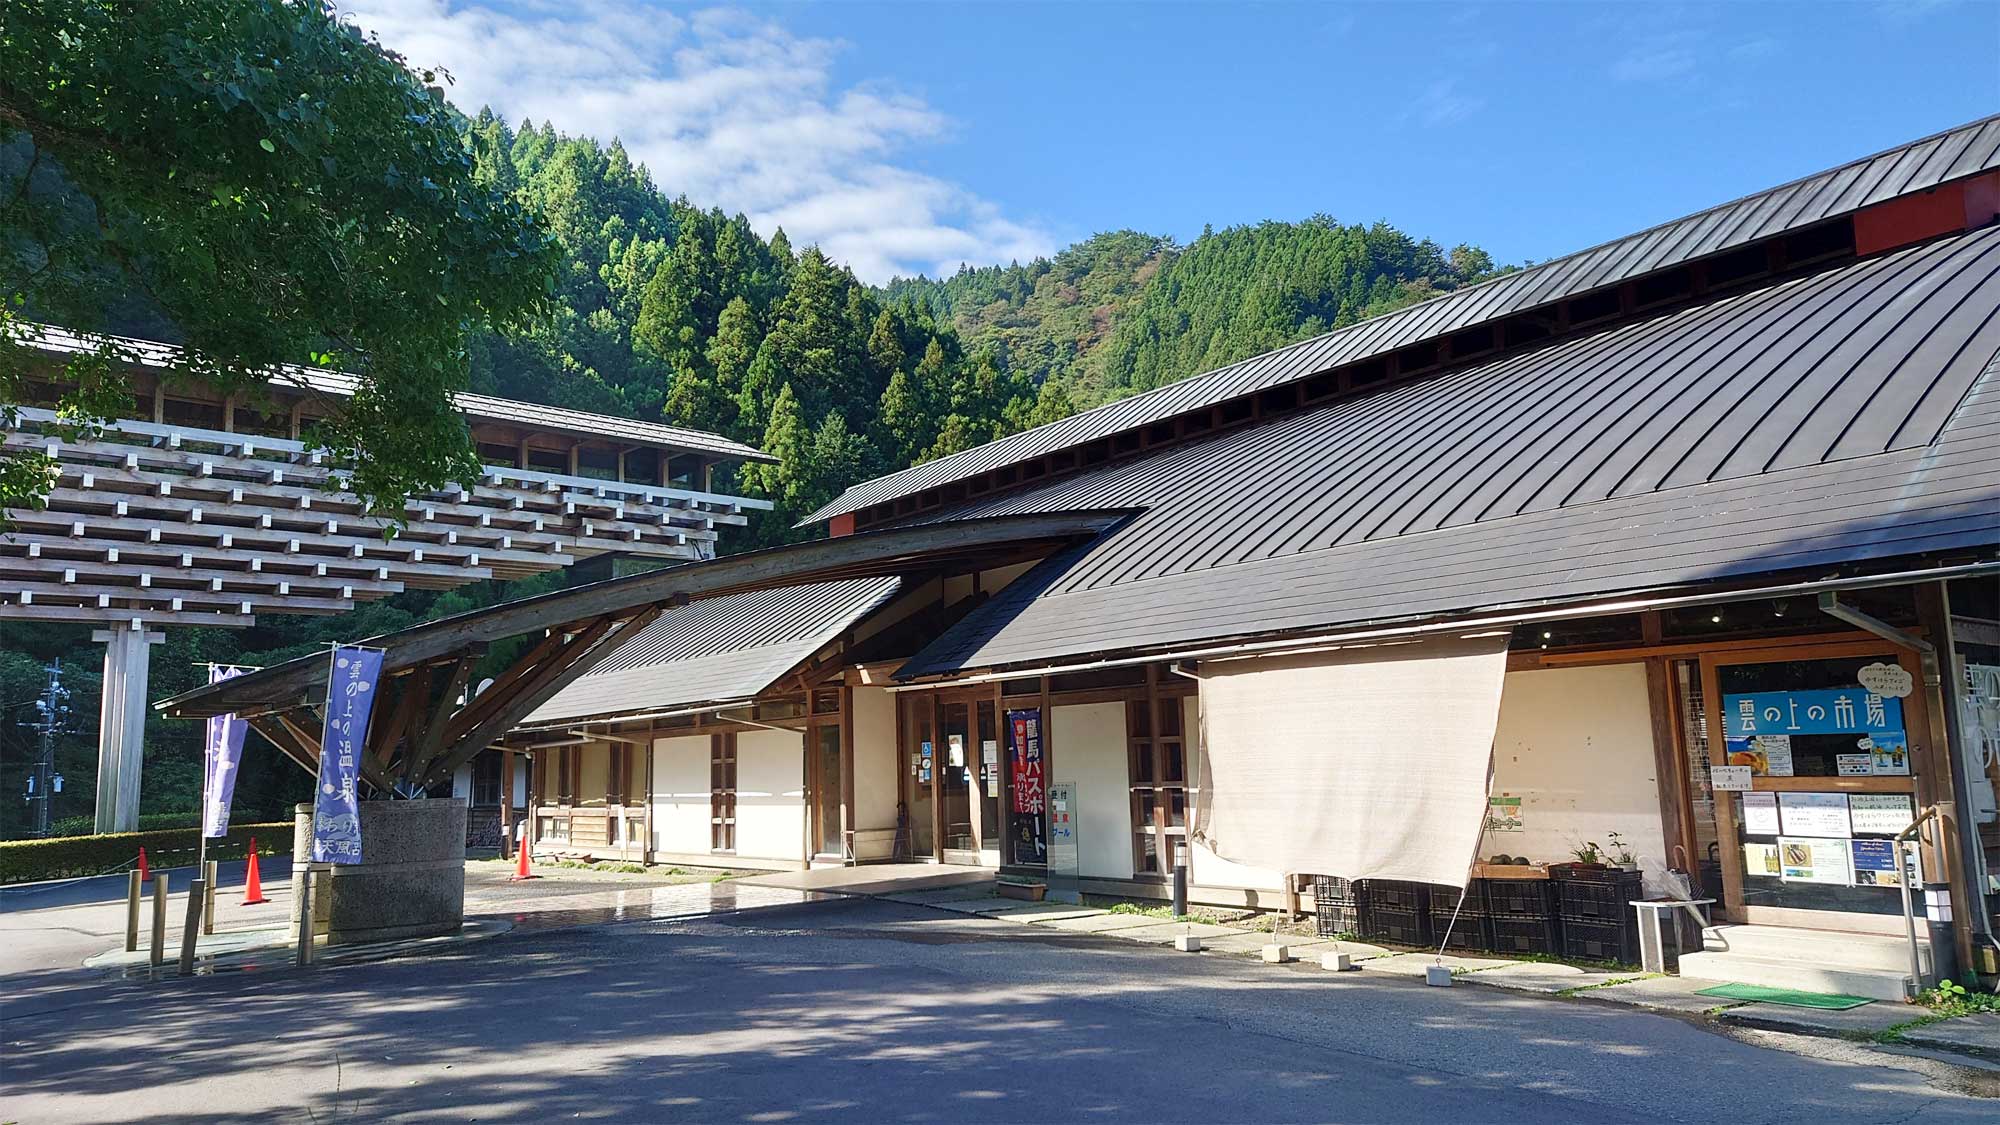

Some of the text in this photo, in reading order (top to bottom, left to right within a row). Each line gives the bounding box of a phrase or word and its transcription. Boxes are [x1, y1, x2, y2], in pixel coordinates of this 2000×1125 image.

[1738, 693, 1886, 731] 雲の上の市場
[333, 660, 362, 804] 雲の上の温泉
[1026, 719, 1046, 856] 龍馬パスポート
[1051, 790, 1067, 800] 受付
[314, 838, 360, 856] 天風呂
